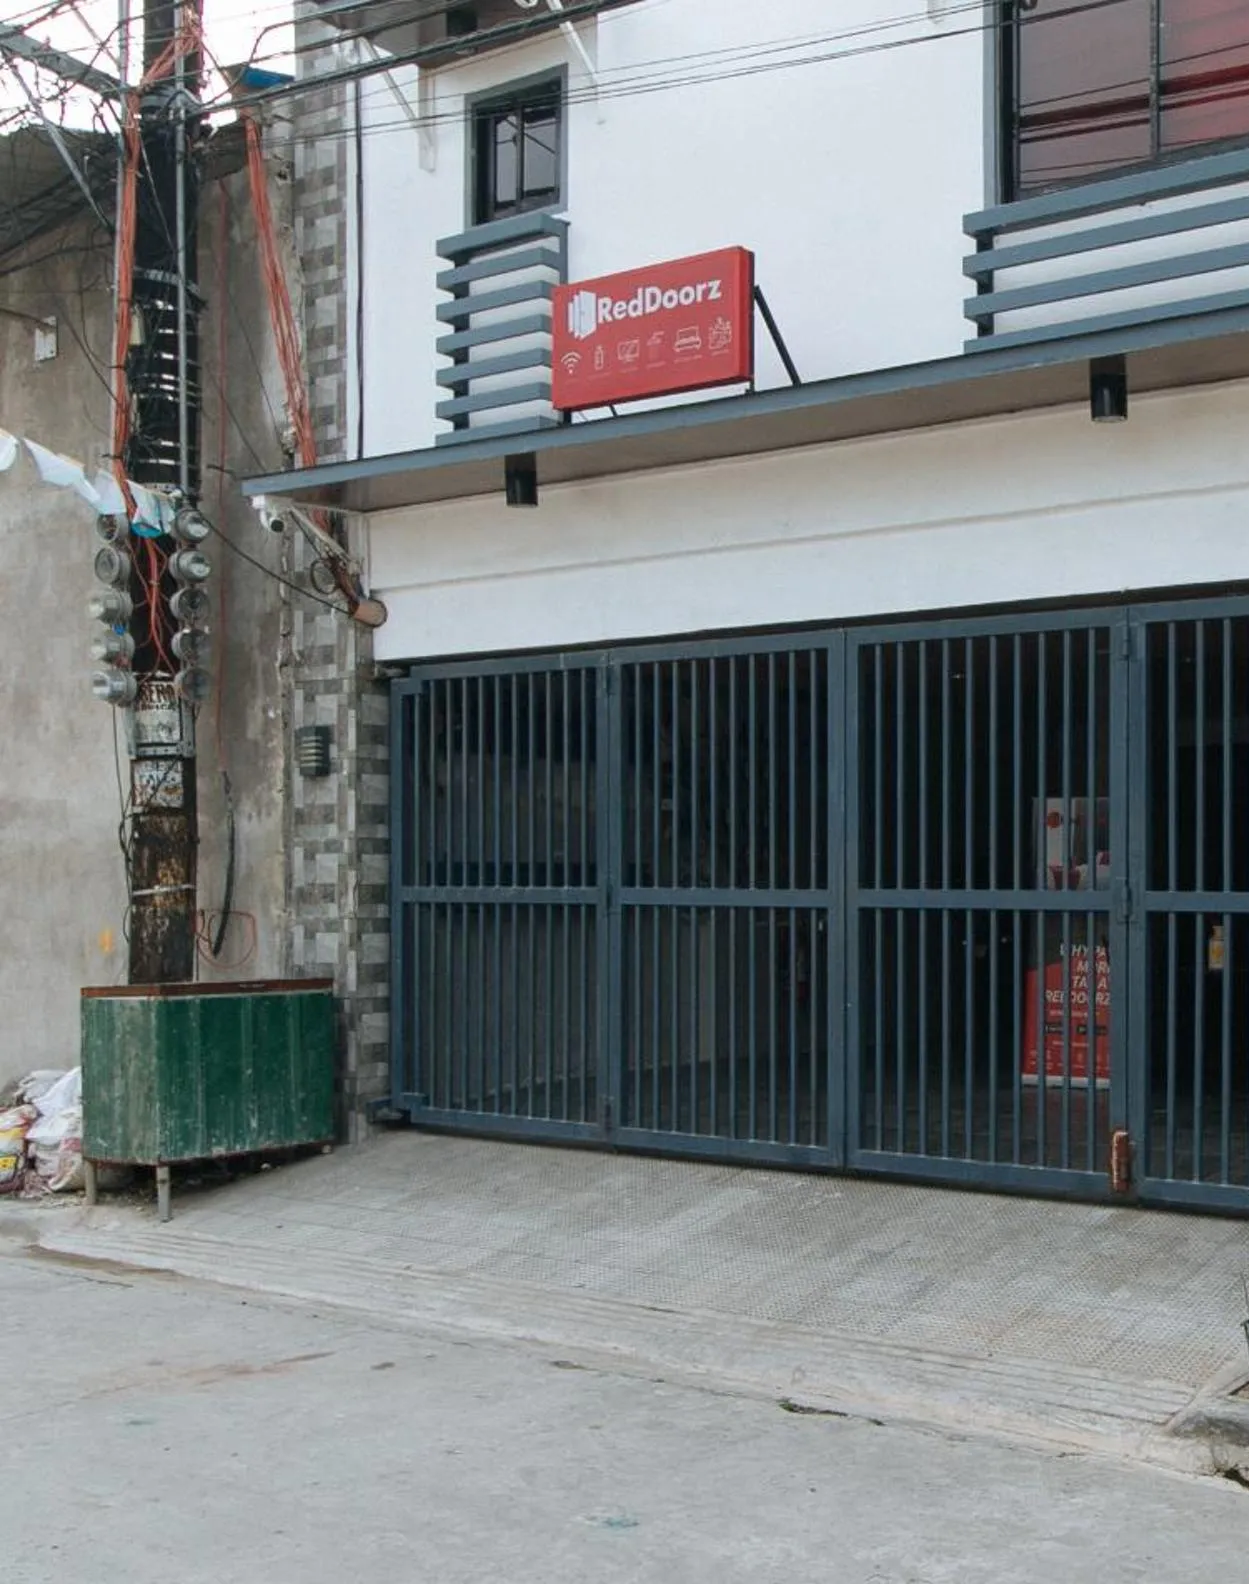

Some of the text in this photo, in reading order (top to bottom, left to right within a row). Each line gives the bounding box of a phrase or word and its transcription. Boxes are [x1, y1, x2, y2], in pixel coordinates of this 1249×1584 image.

[598, 279, 722, 325] RedDoorz
[1076, 960, 1110, 974] MR
[1071, 975, 1107, 990] TAA
[1044, 989, 1112, 1006] REDORZ
